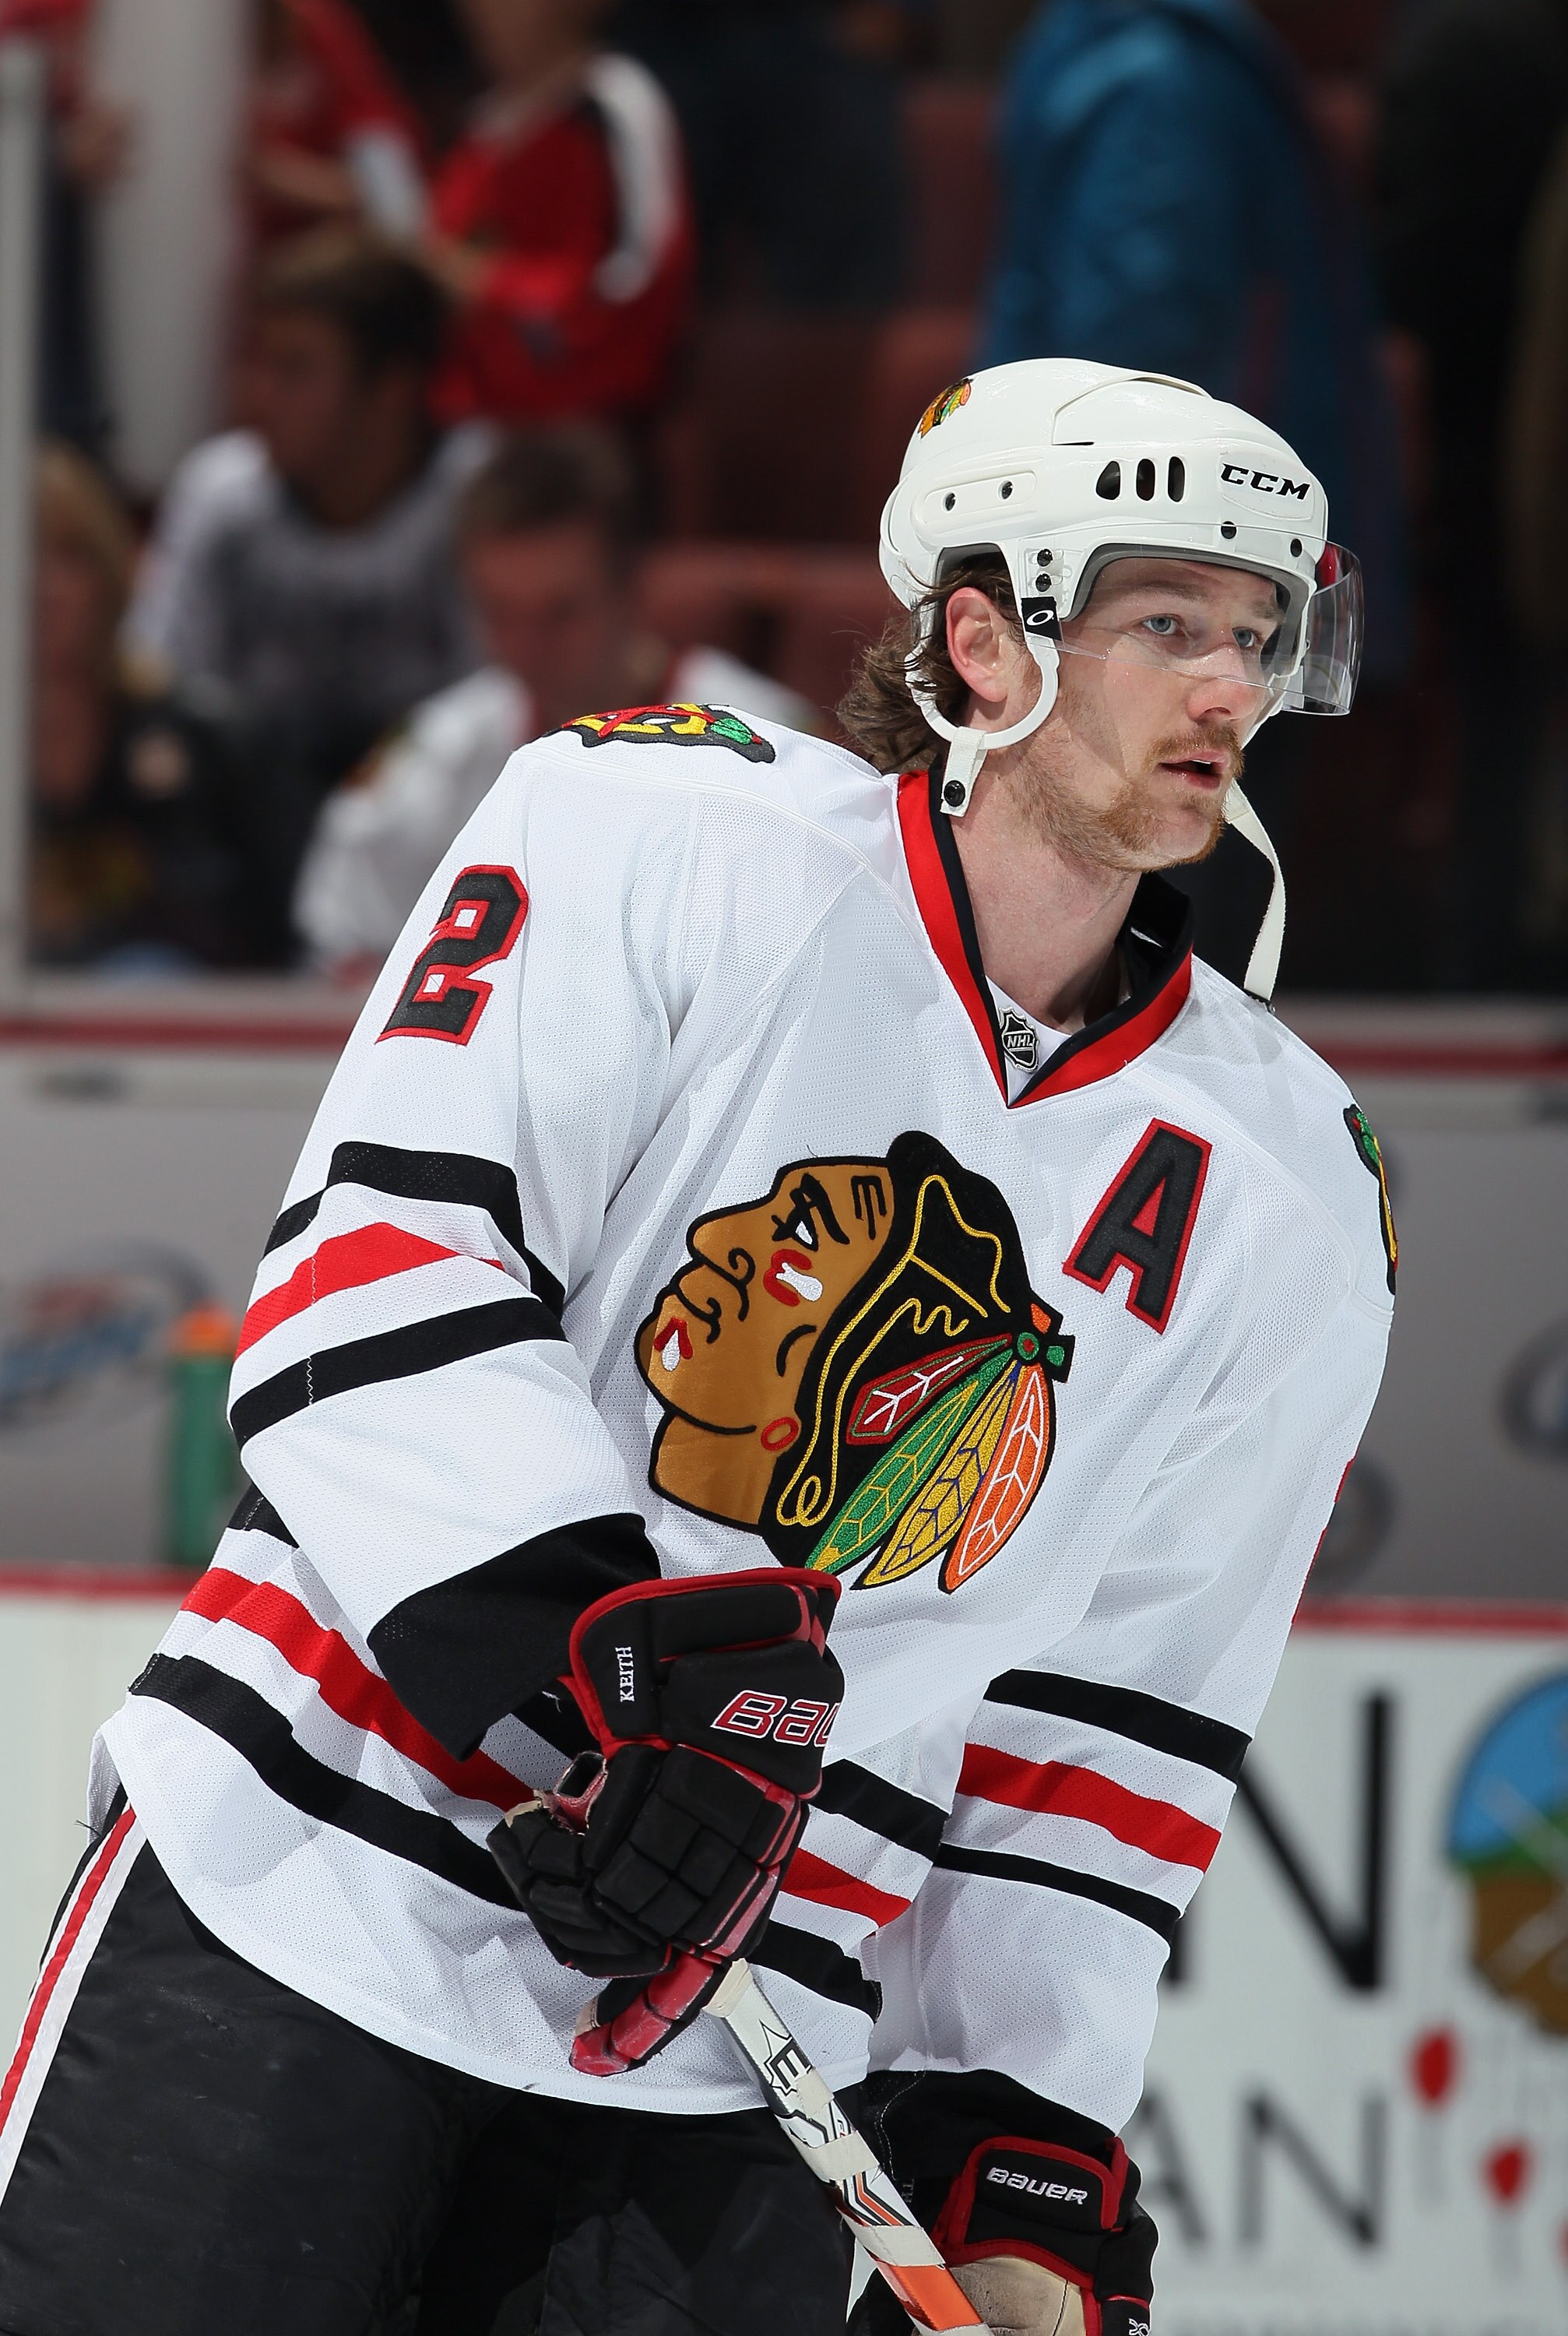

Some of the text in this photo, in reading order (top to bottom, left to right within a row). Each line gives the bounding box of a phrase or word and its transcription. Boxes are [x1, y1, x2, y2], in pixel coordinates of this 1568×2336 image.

[1221, 463, 1310, 500] CCM
[374, 864, 529, 1046] 2
[1007, 1034, 1034, 1048] NHL
[1062, 1117, 1212, 1335] A
[615, 1646, 635, 1703] KEITH
